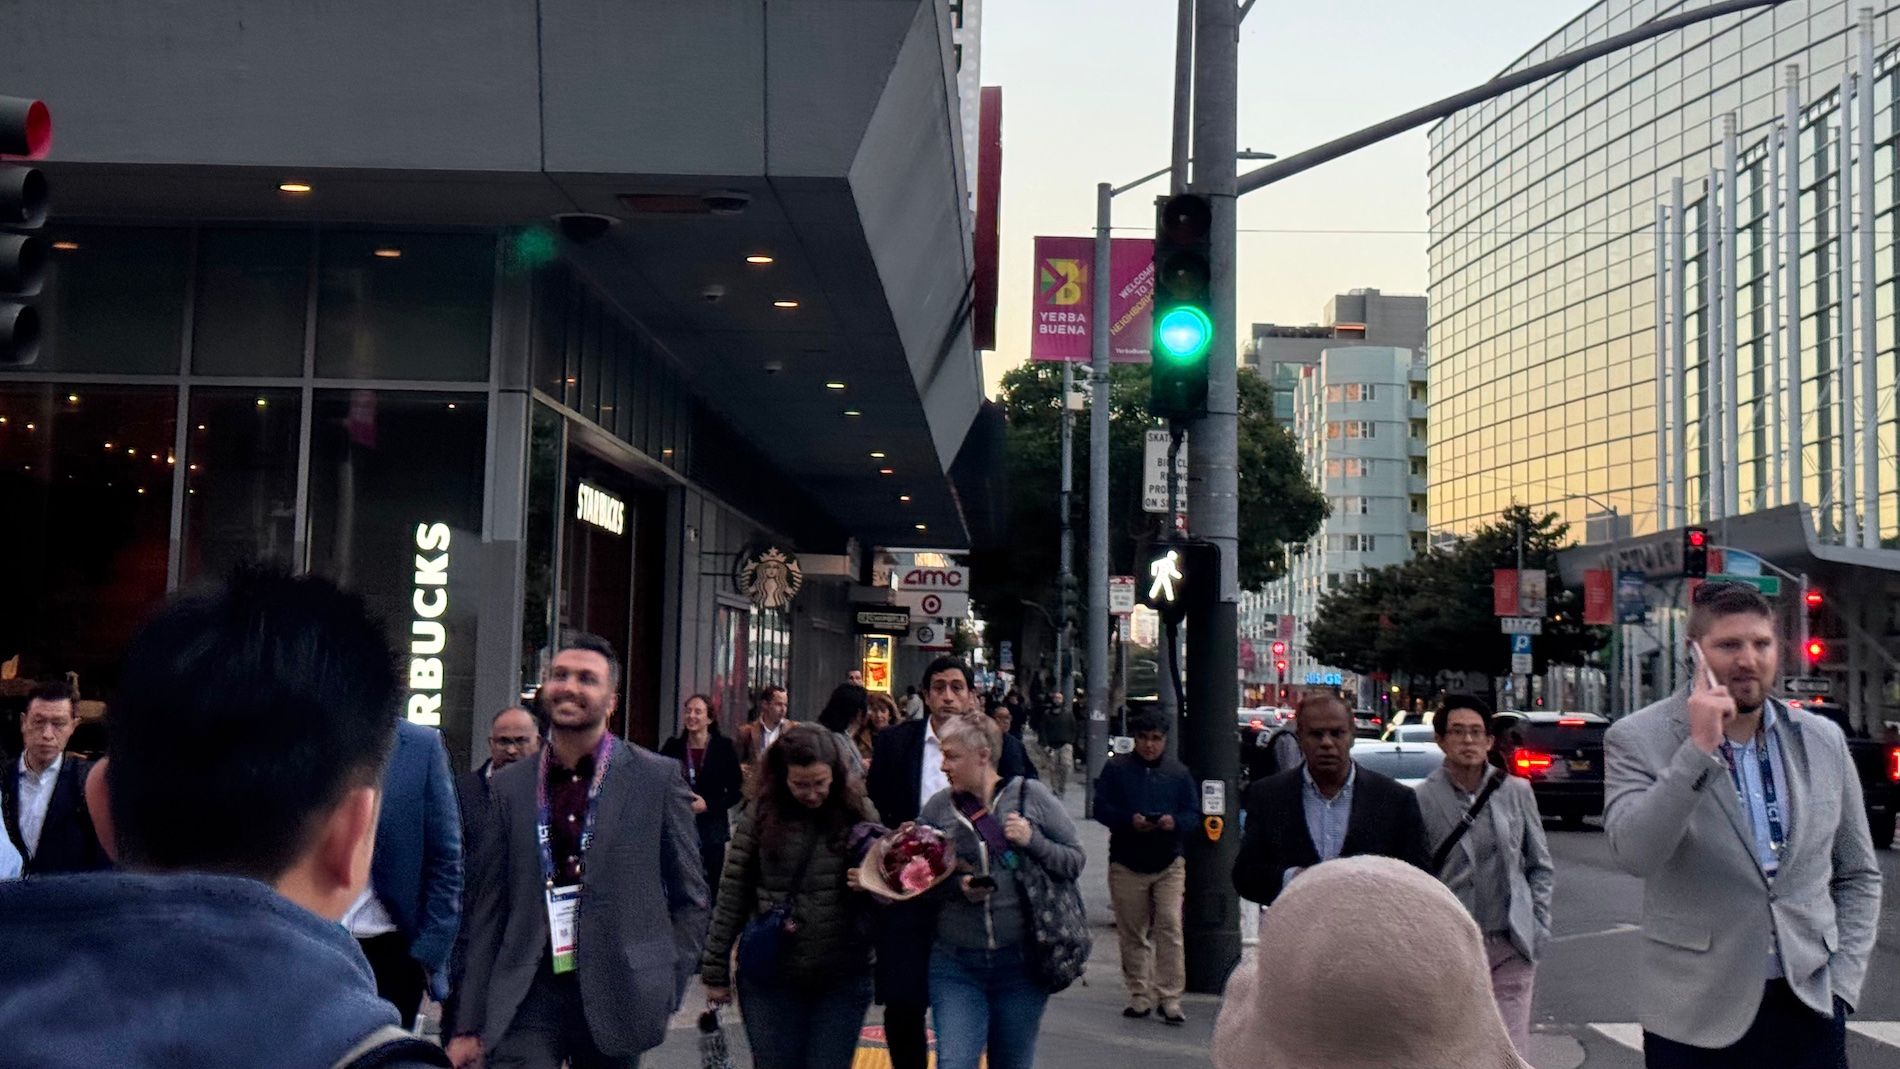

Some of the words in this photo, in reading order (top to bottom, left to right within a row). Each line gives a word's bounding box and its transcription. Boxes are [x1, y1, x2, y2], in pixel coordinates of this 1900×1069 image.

[1134, 285, 1147, 297] TO
[1146, 276, 1154, 287] T
[1040, 312, 1087, 322] YERBA
[1040, 324, 1086, 335] BUENA
[577, 482, 624, 535] STARBUCKS
[1145, 498, 1157, 507] ON
[408, 522, 451, 726] RBUCKS
[1515, 635, 1530, 652] P
